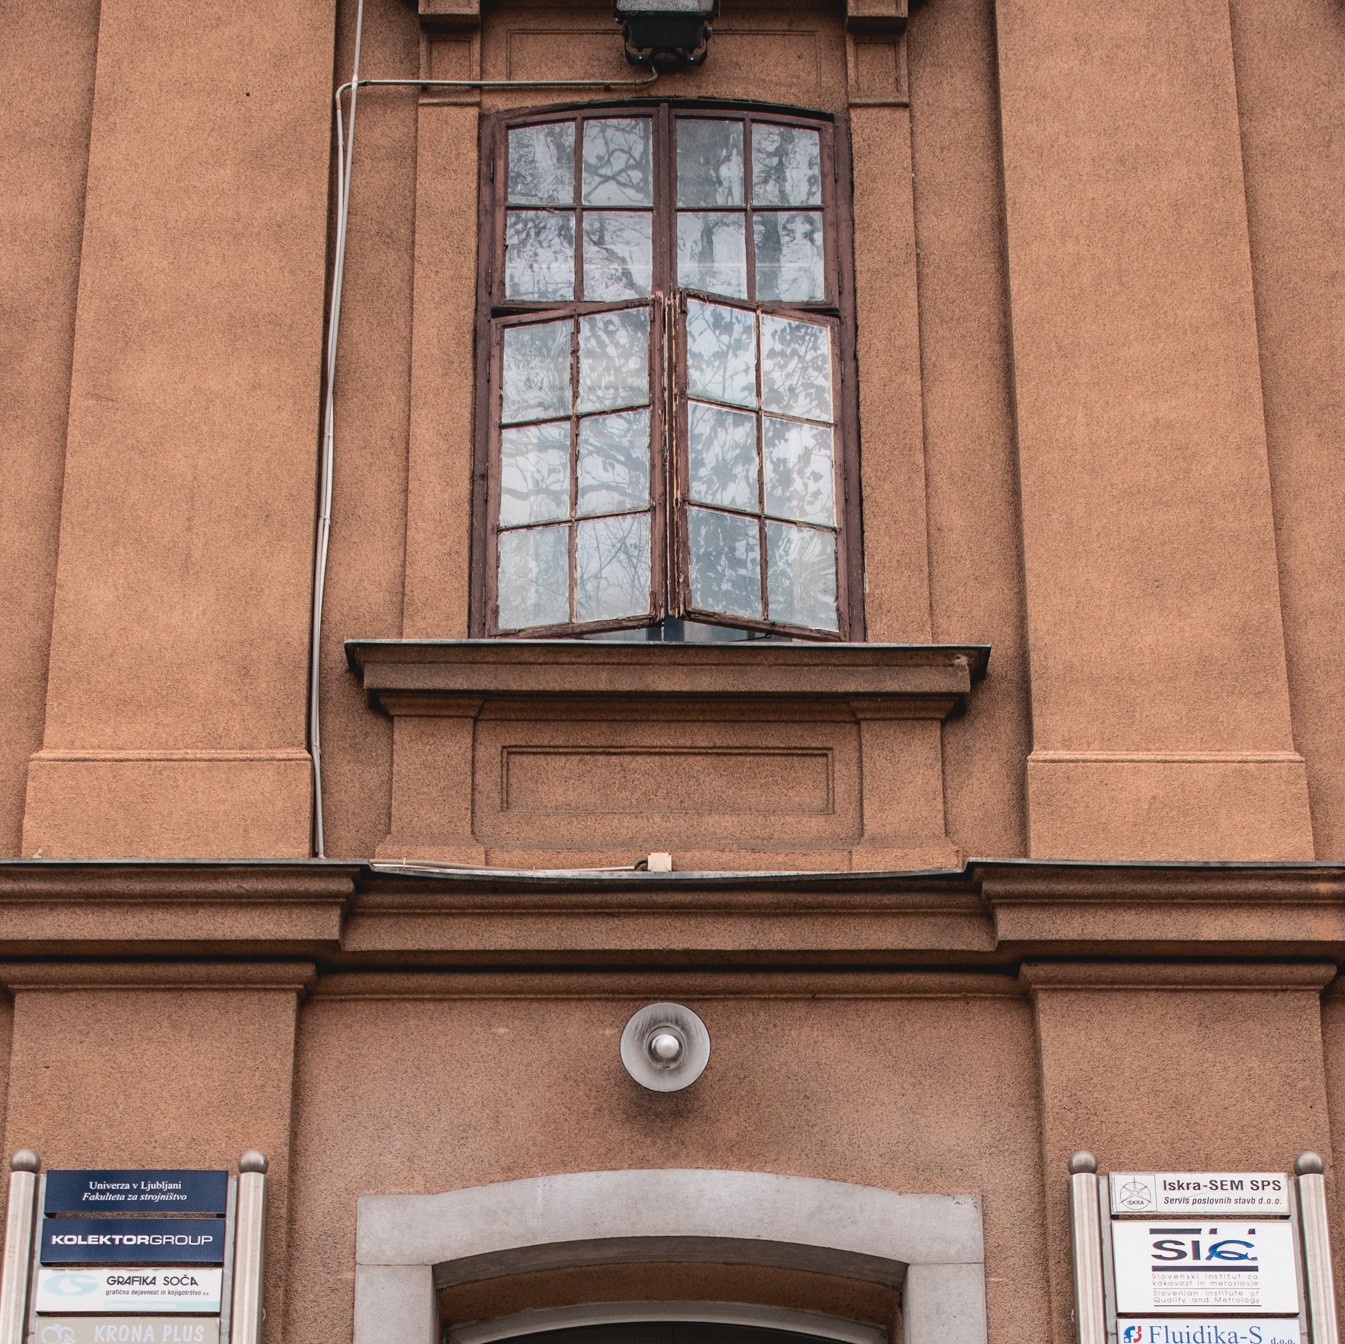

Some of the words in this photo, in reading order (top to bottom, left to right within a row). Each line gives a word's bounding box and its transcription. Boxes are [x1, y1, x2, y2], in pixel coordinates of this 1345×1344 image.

[89, 1181, 129, 1189] Univerza
[141, 1181, 181, 1191] Ljubljani
[1163, 1180, 1244, 1190] Iskra-SEM
[1250, 1180, 1281, 1190] SPS
[83, 1193, 125, 1201] Fakulteta
[140, 1193, 187, 1202] strojništvo
[1192, 1197, 1232, 1206] poslovnih
[51, 1235, 213, 1245] KOLEKTORGROUP
[107, 1276, 156, 1285] GRAFIKA
[163, 1274, 198, 1286] SOČA
[94, 1325, 155, 1341] KRONA
[163, 1325, 204, 1341] PLUS
[1149, 1326, 1262, 1344] Fluidika-S
[1271, 1337, 1295, 1344] d.o.o.
